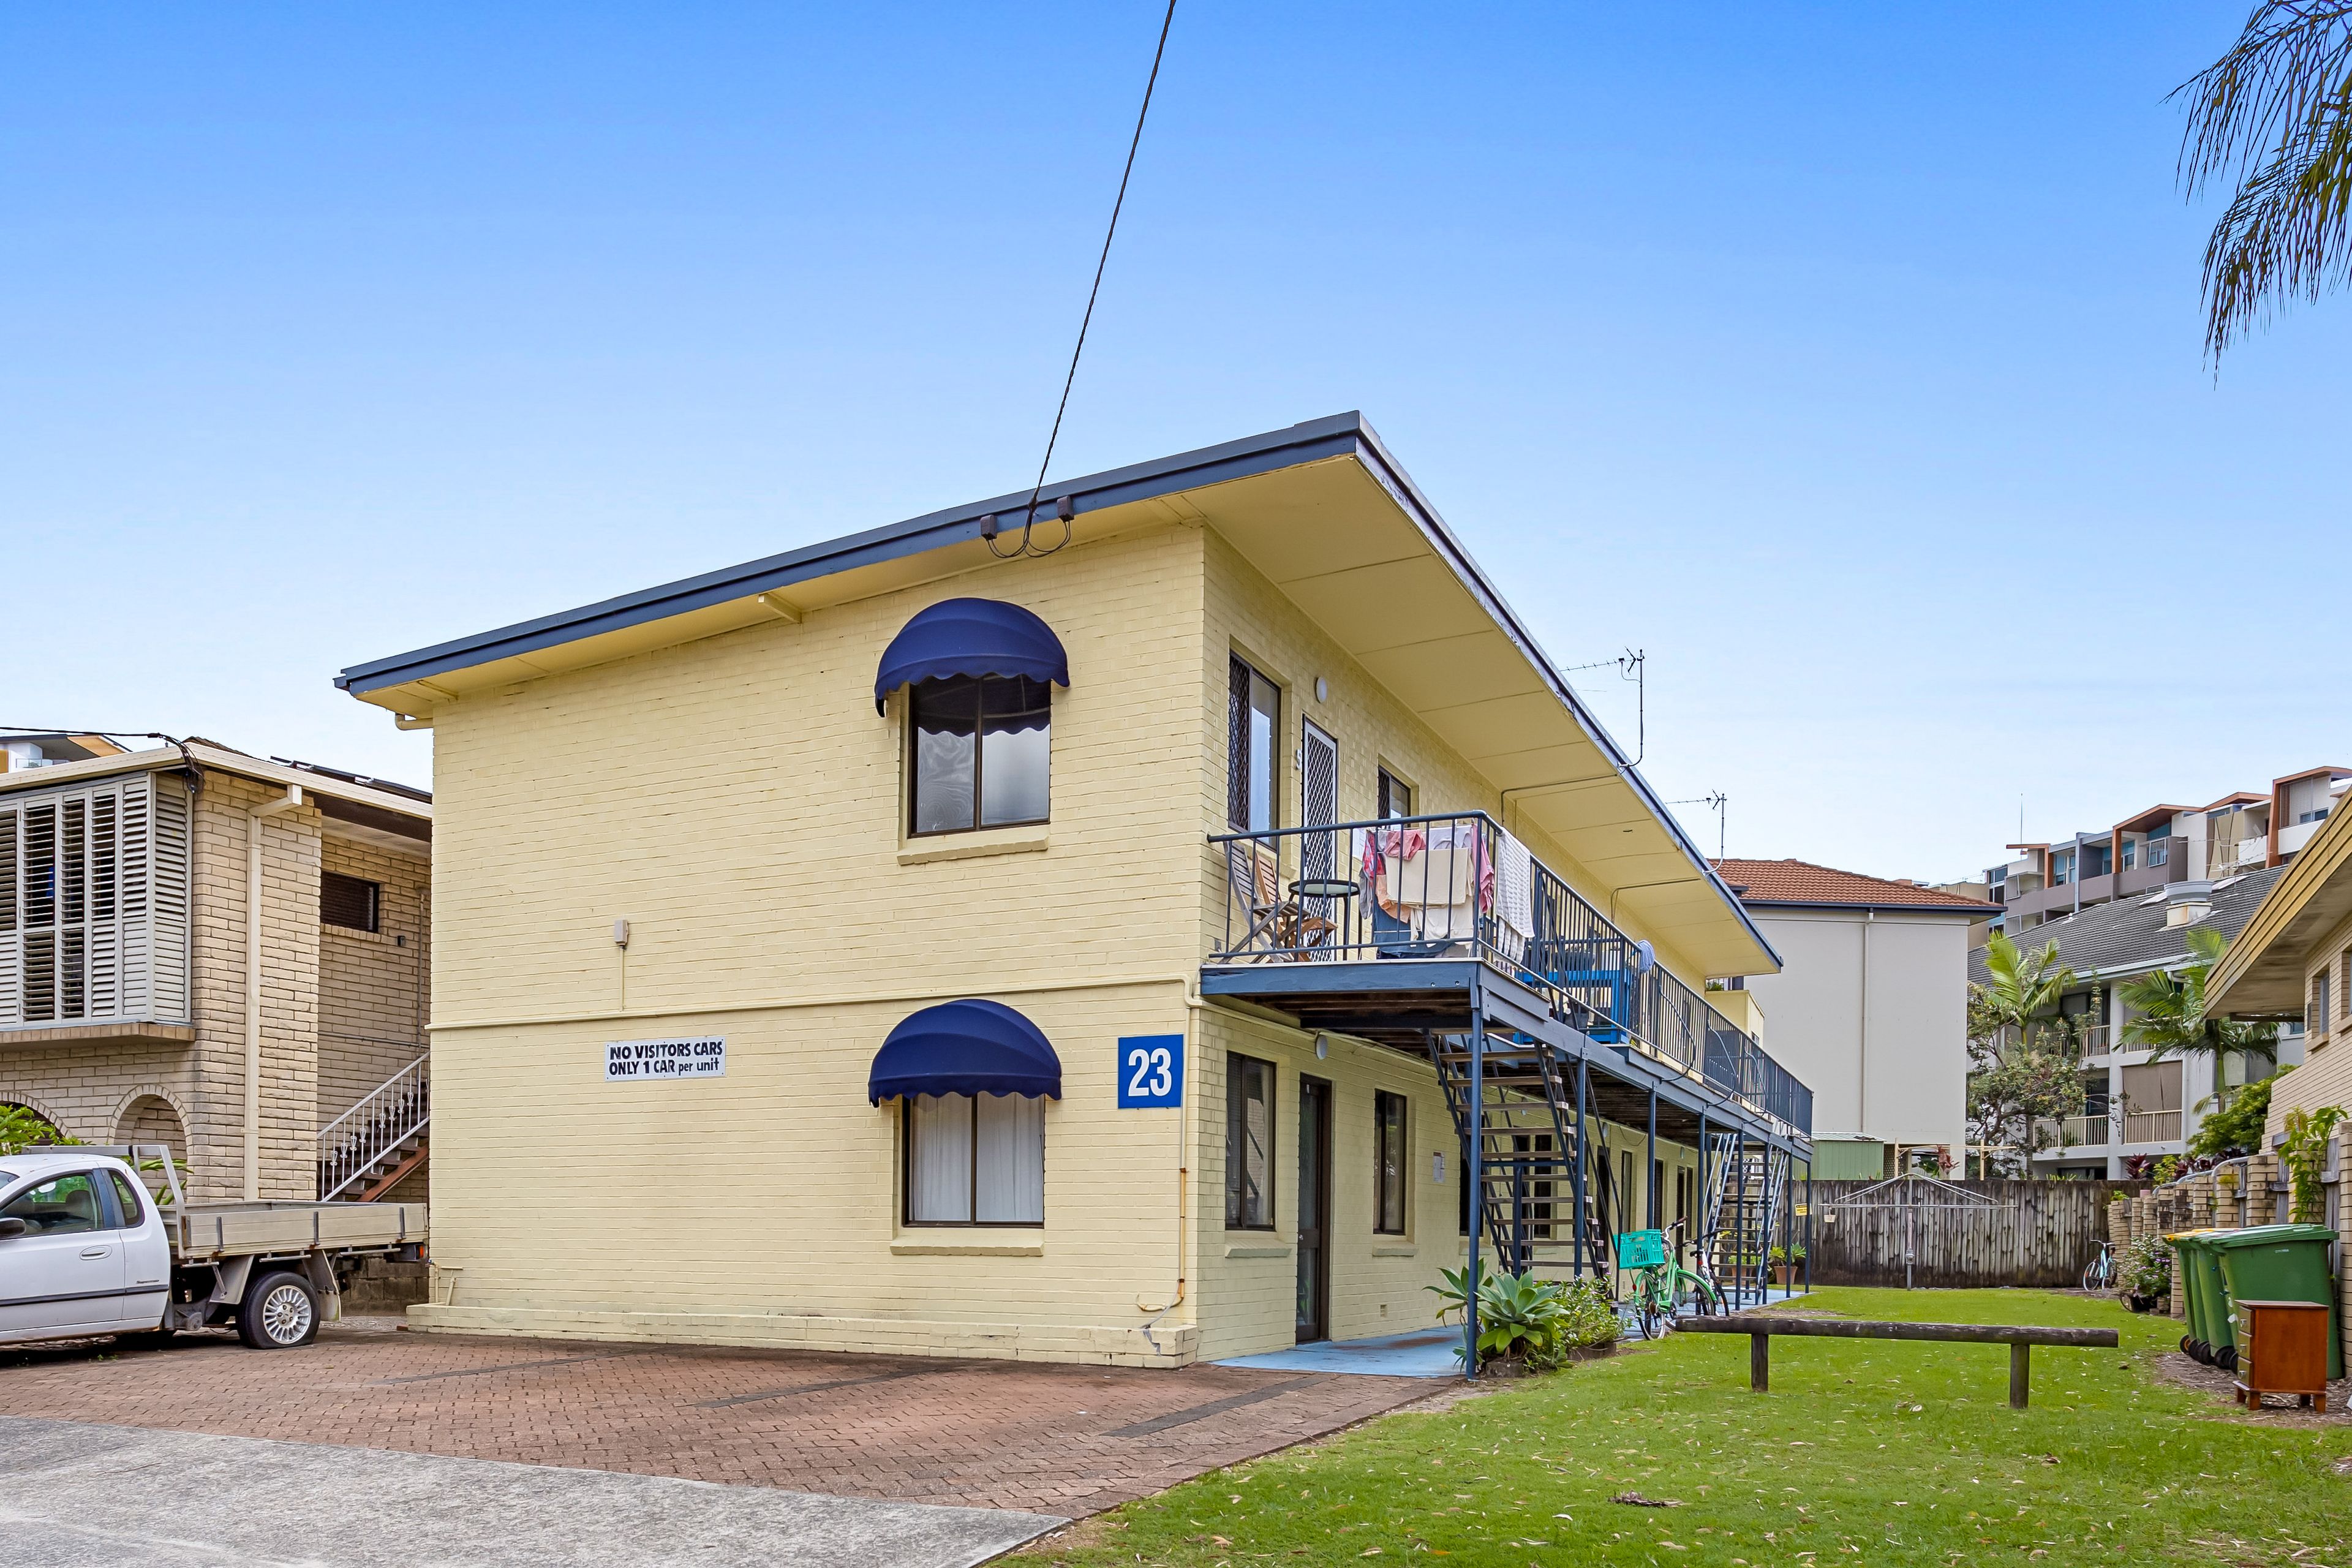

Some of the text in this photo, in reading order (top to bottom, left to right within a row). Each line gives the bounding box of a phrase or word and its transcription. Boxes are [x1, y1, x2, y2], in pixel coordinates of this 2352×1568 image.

[610, 1041, 723, 1060] NO VISITORS CARS
[609, 1057, 719, 1076] ONLY 1 CAR per unit
[1128, 1048, 1172, 1096] 23
